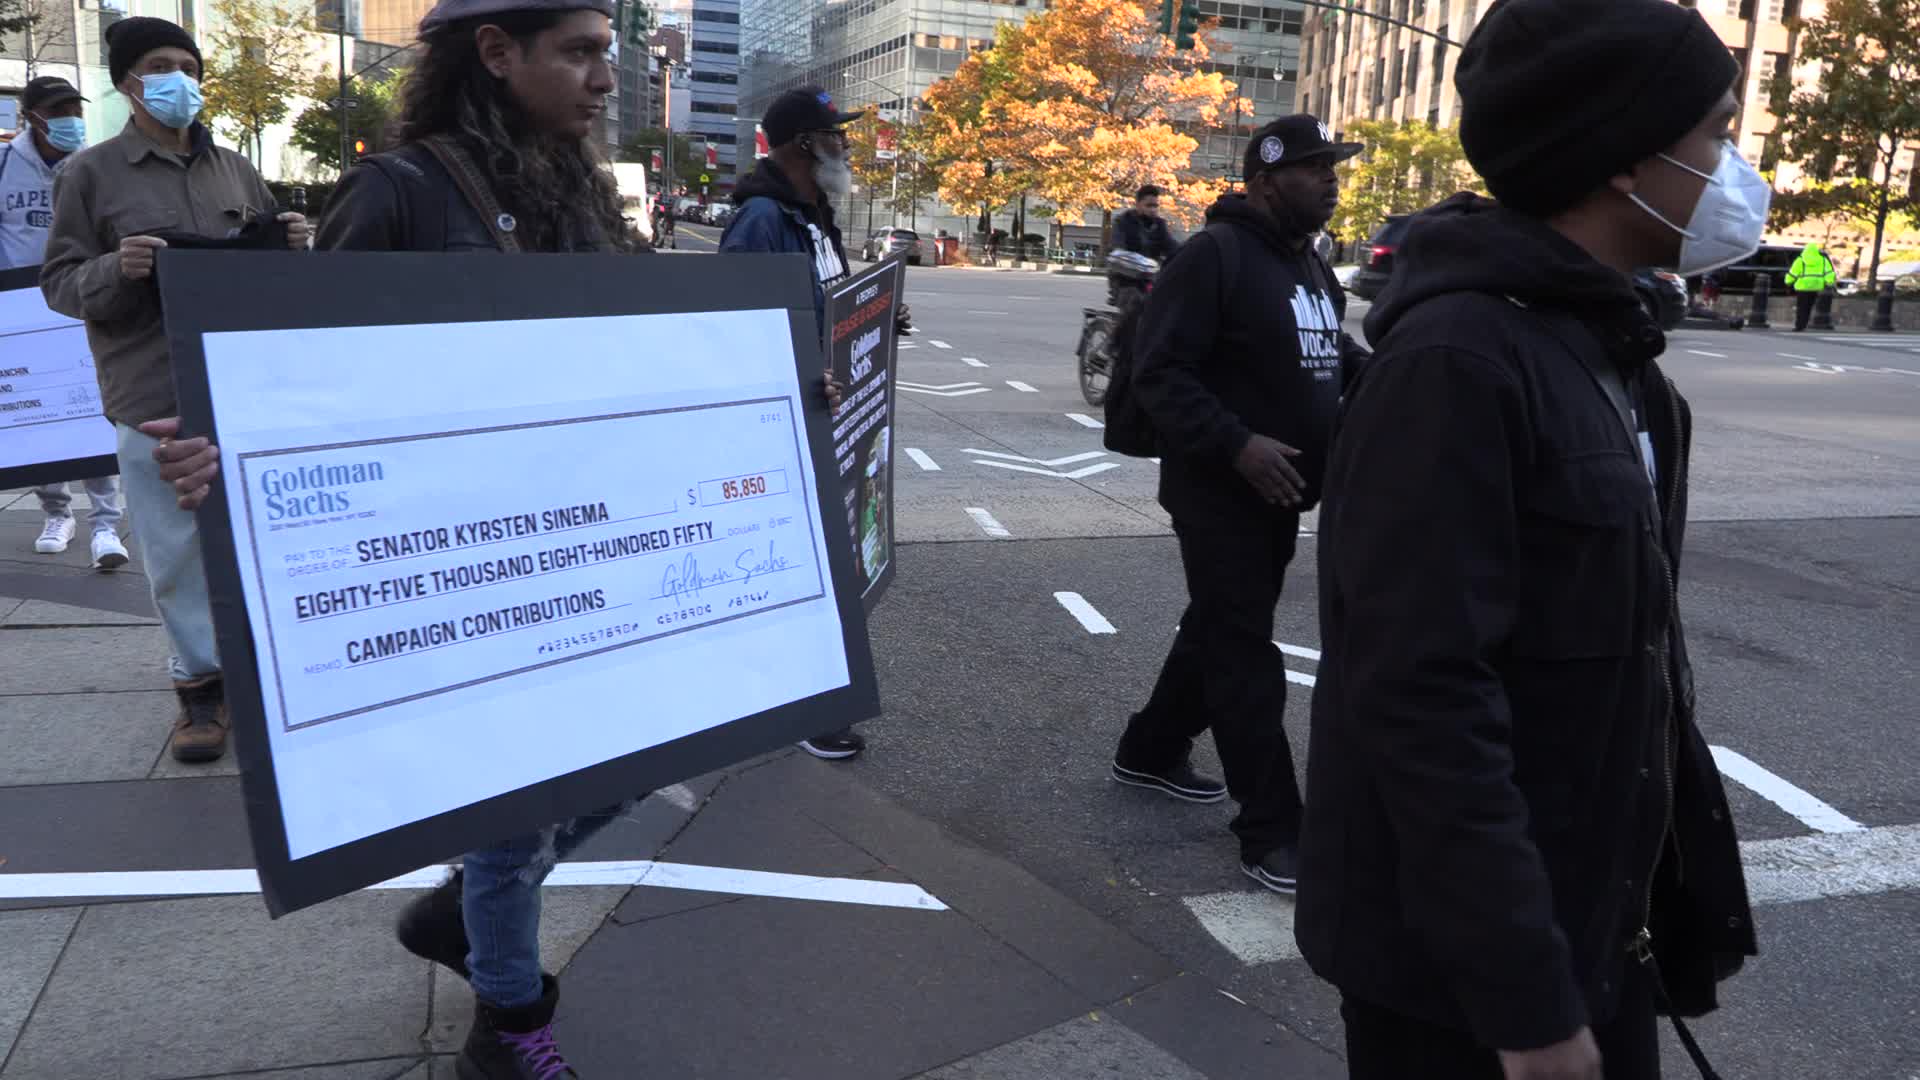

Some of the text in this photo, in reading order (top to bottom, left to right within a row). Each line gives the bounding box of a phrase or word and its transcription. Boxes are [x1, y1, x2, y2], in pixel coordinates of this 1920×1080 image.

[261, 461, 384, 497] Goldman
[687, 476, 766, 505] $ 85,850
[265, 490, 351, 521] Sachs
[356, 502, 609, 563] SENATOR KYRSTEN SINEMA
[294, 521, 713, 619] EIGHTY-FIVE THOUSAND EIGHT-HUNDRED FIFTY
[303, 588, 606, 675] MEMO CAMPAIGN CONTRIBUTIONS
